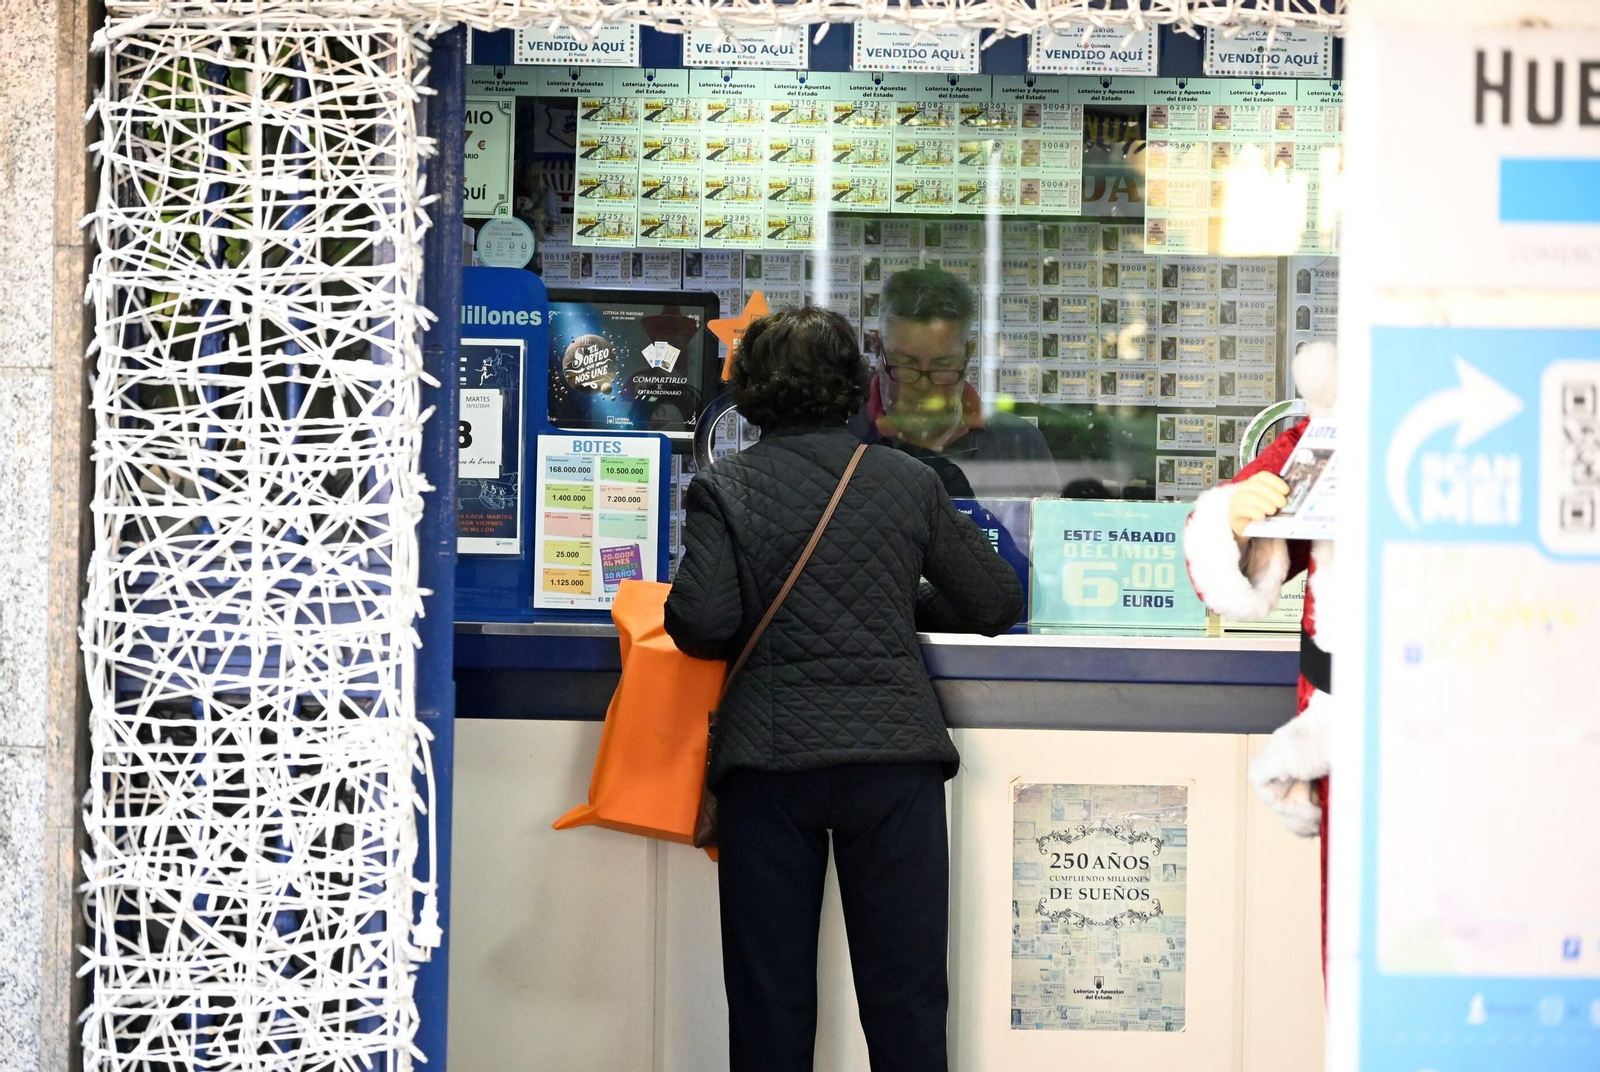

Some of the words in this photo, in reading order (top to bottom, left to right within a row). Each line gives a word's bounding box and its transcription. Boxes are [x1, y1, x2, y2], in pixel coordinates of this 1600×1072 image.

[528, 42, 588, 51] VENDIDO
[592, 40, 625, 54] AQUÍ
[866, 48, 927, 58] VENDIDO
[1046, 50, 1106, 60] VENDIDO
[1110, 48, 1143, 62] AQUÍ
[1219, 54, 1280, 64] VENDIDO
[1284, 52, 1318, 66] AQUÍ
[850, 178, 878, 186] 44923
[572, 348, 609, 368] SORTEO
[575, 371, 590, 384] NOS
[591, 365, 608, 378] UNE
[633, 376, 687, 384] COMPARTIRLO
[573, 440, 622, 453] BOTES
[1064, 530, 1102, 541] ESTE
[1108, 528, 1176, 542] SÁBADO
[603, 551, 635, 560] 20.000€
[616, 569, 636, 578] AÑOS
[1062, 561, 1175, 607] 6,00
[1123, 595, 1174, 608] EUROS
[1050, 853, 1088, 870] 250
[1093, 852, 1149, 870] AÑOS
[1050, 888, 1072, 900] DE
[1079, 885, 1150, 900] SUEÑOS
